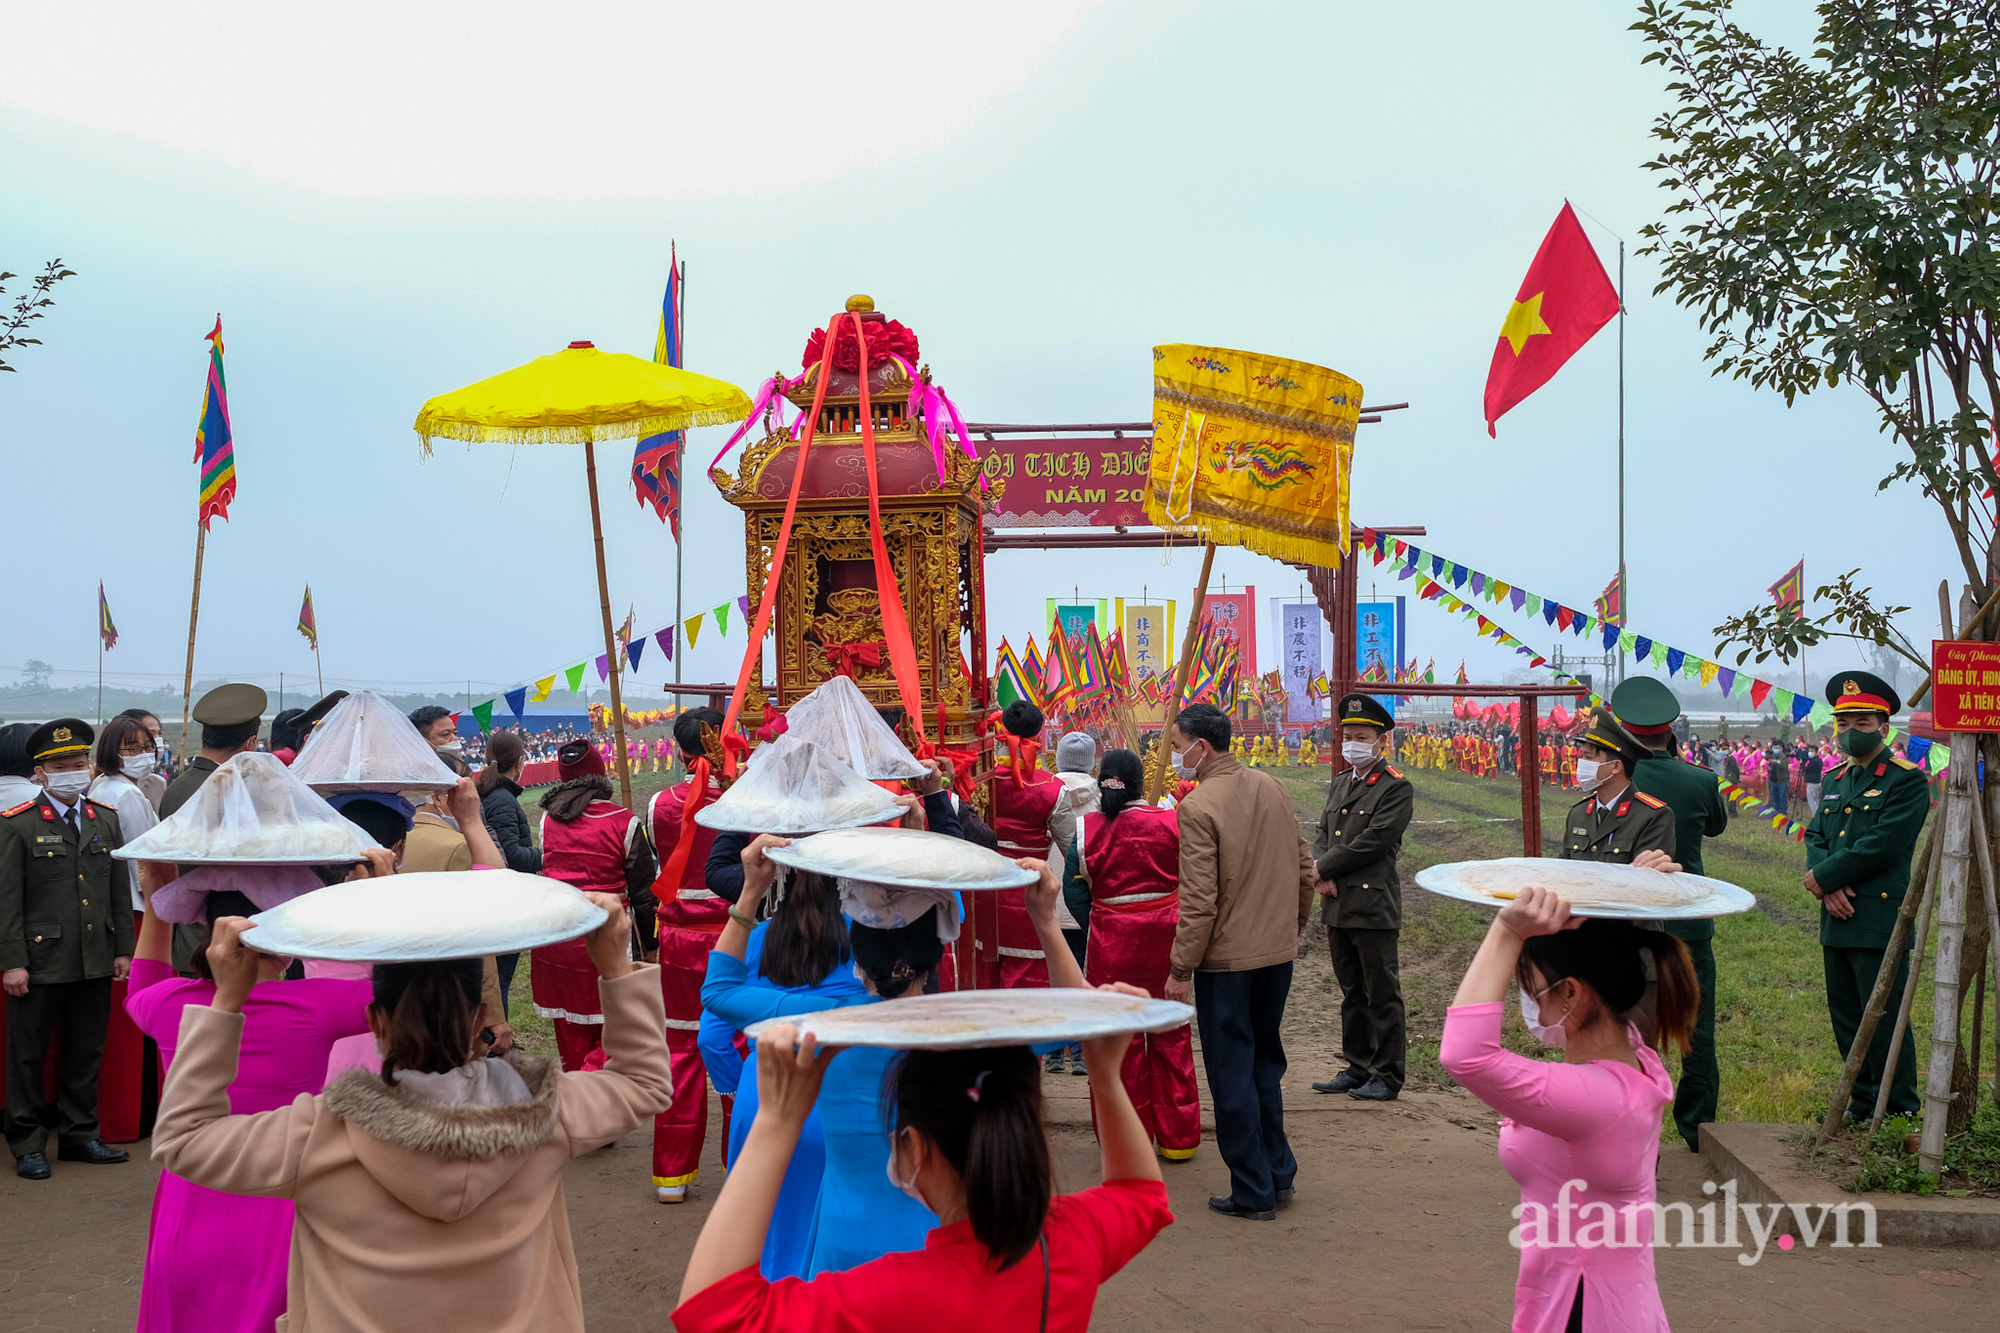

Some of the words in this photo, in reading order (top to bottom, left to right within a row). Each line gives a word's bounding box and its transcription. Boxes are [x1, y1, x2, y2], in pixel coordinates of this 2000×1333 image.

[984, 447, 1015, 483] ỘI
[1025, 451, 1091, 483] TỊCH
[1100, 438, 1151, 477] DIỀ
[1046, 485, 1107, 504] NĂM
[1115, 488, 1145, 503] 20
[1364, 613, 1380, 660] 非工不
[1948, 651, 1965, 662] Cây
[1938, 663, 1963, 685] ĐẢNG
[1965, 664, 1980, 687] ỦY,
[1983, 671, 2000, 686] HĐN
[1959, 692, 1971, 709] XÃ
[1974, 692, 1994, 710] TIÊN
[1957, 714, 1981, 726] Lưu
